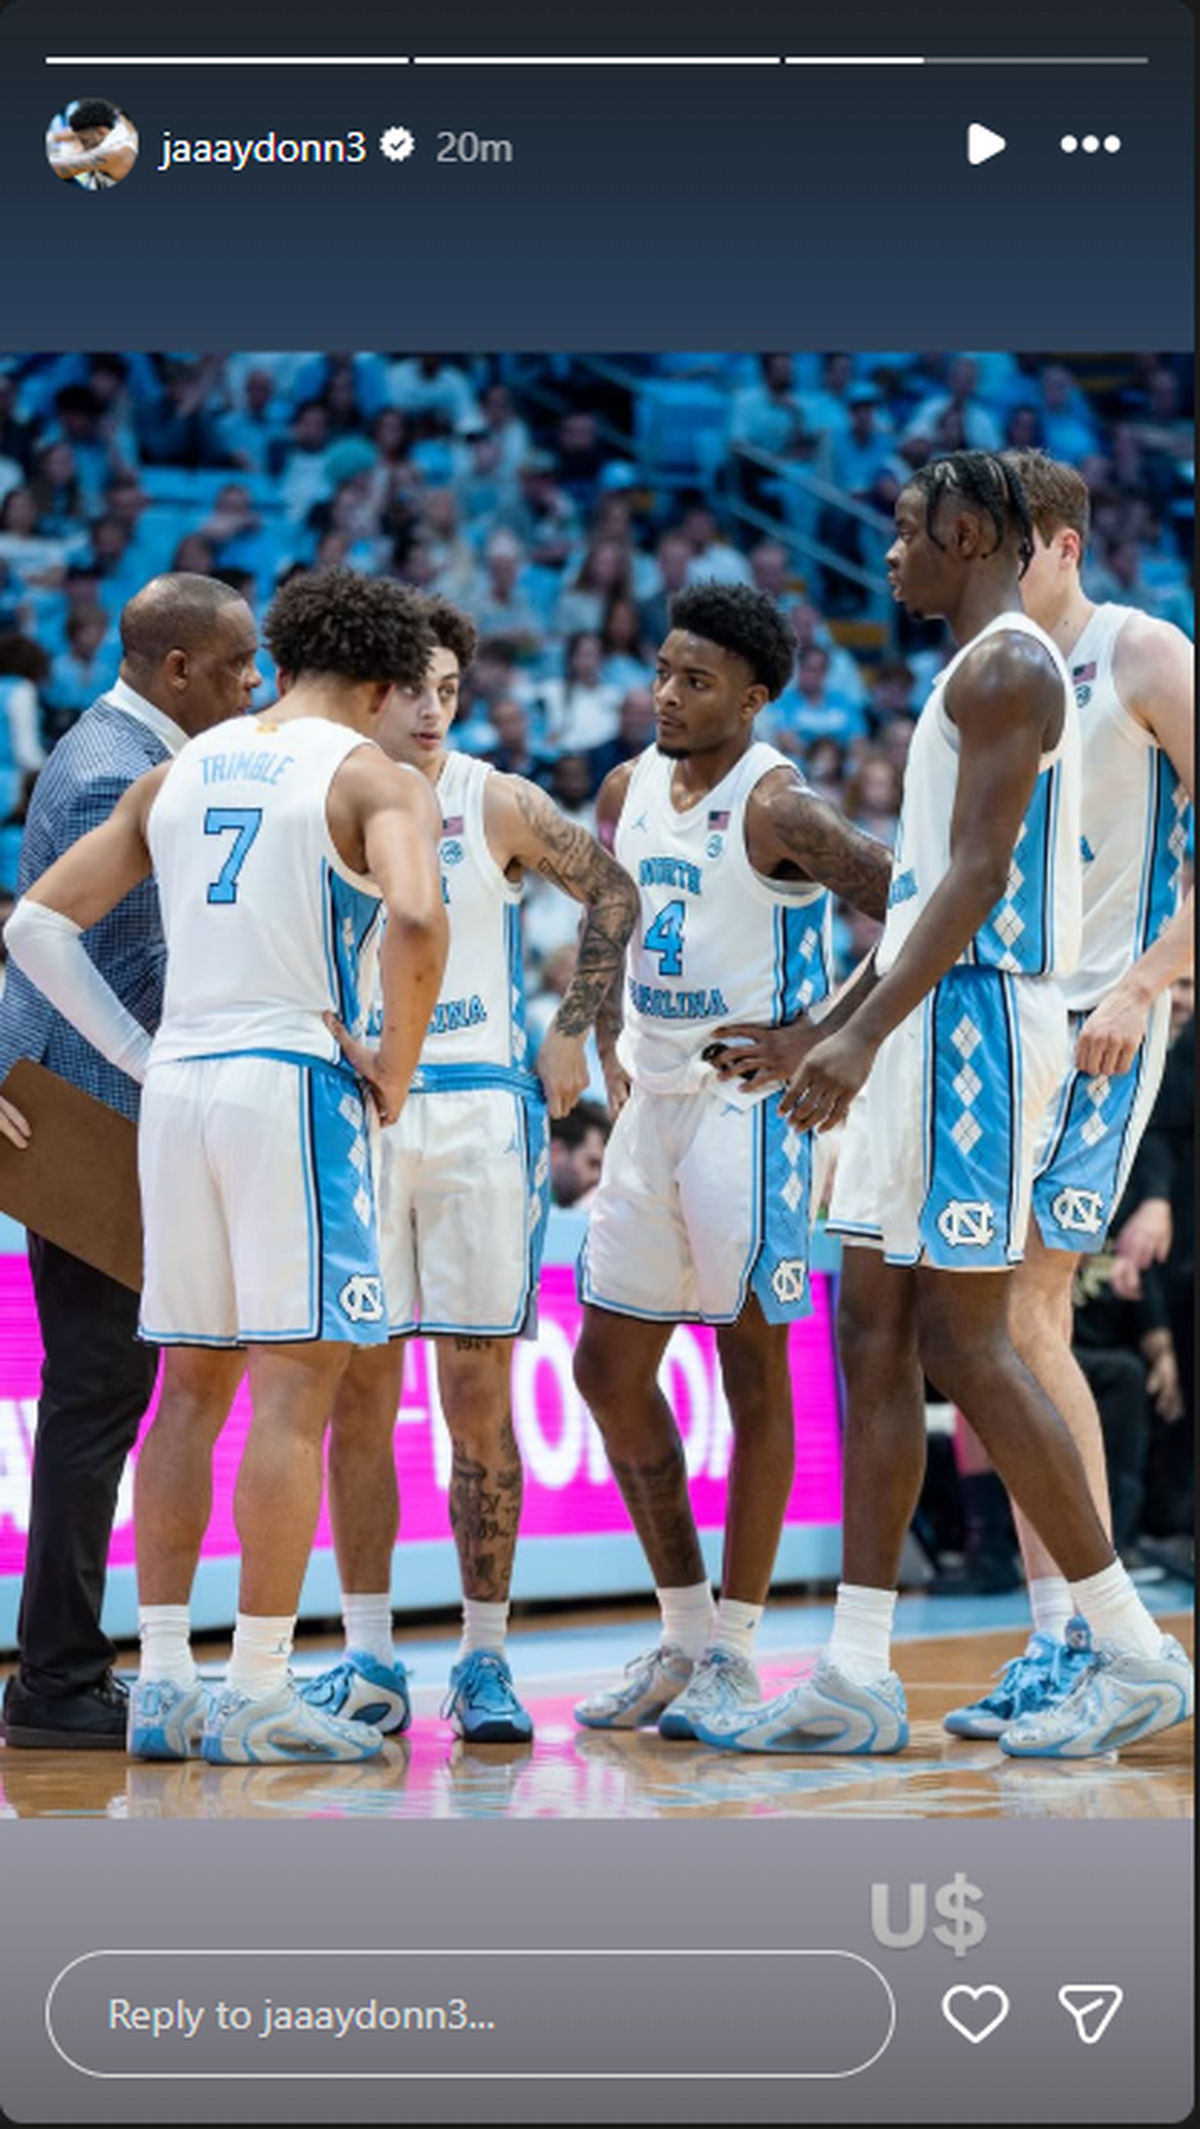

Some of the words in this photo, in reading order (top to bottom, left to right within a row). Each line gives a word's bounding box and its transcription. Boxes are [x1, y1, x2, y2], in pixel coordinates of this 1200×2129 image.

[200, 751, 294, 786] TRIMBLE
[204, 808, 263, 904] 7
[643, 900, 686, 976] 4
